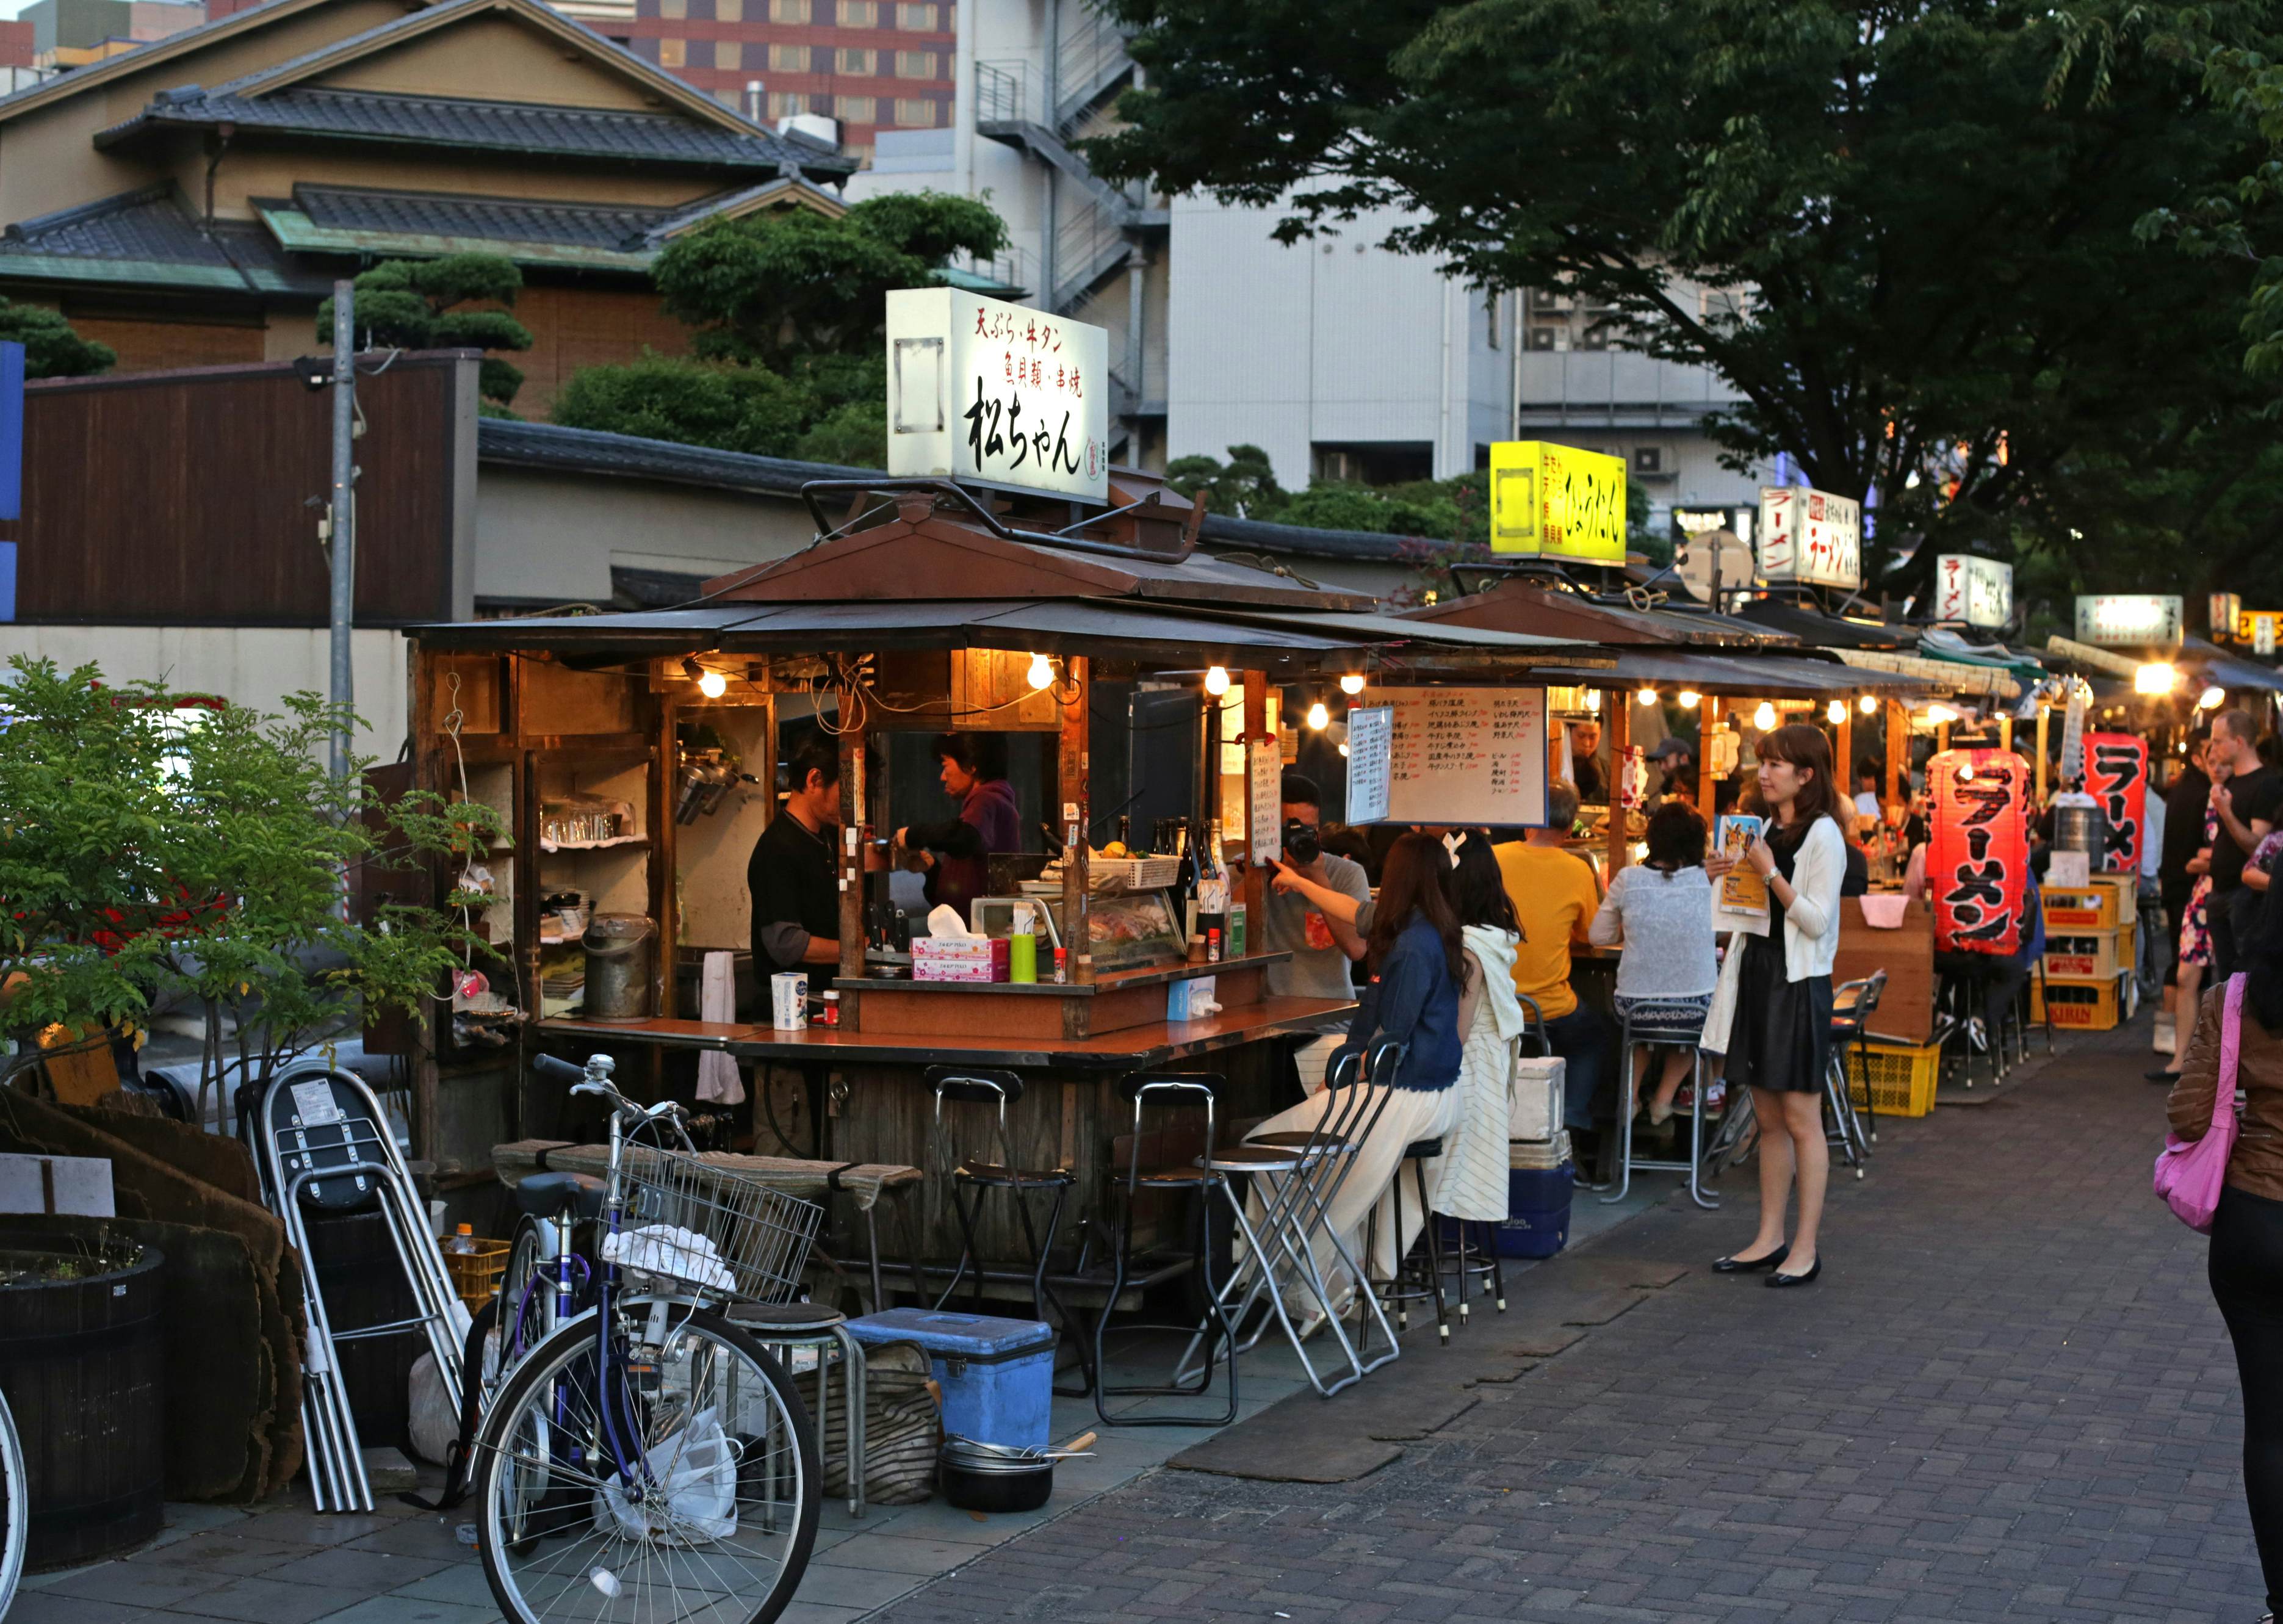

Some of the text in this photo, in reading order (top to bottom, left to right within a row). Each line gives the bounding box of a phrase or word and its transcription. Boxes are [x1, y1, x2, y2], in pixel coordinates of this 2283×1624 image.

[975, 307, 1062, 353] 天ぷら・牛タン
[1003, 350, 1083, 399] 魚貝類・串焼
[963, 375, 1081, 475] 松ちゃん
[1565, 471, 1618, 543] ひょうたん
[1761, 490, 1792, 569] ラーメン
[1809, 527, 1843, 572] ラーメン
[1943, 559, 1961, 620] ラーメン
[2095, 742, 2141, 871] ラーメ
[1943, 768, 2013, 945] ラーメン
[2050, 1007, 2090, 1024] KIRIN
